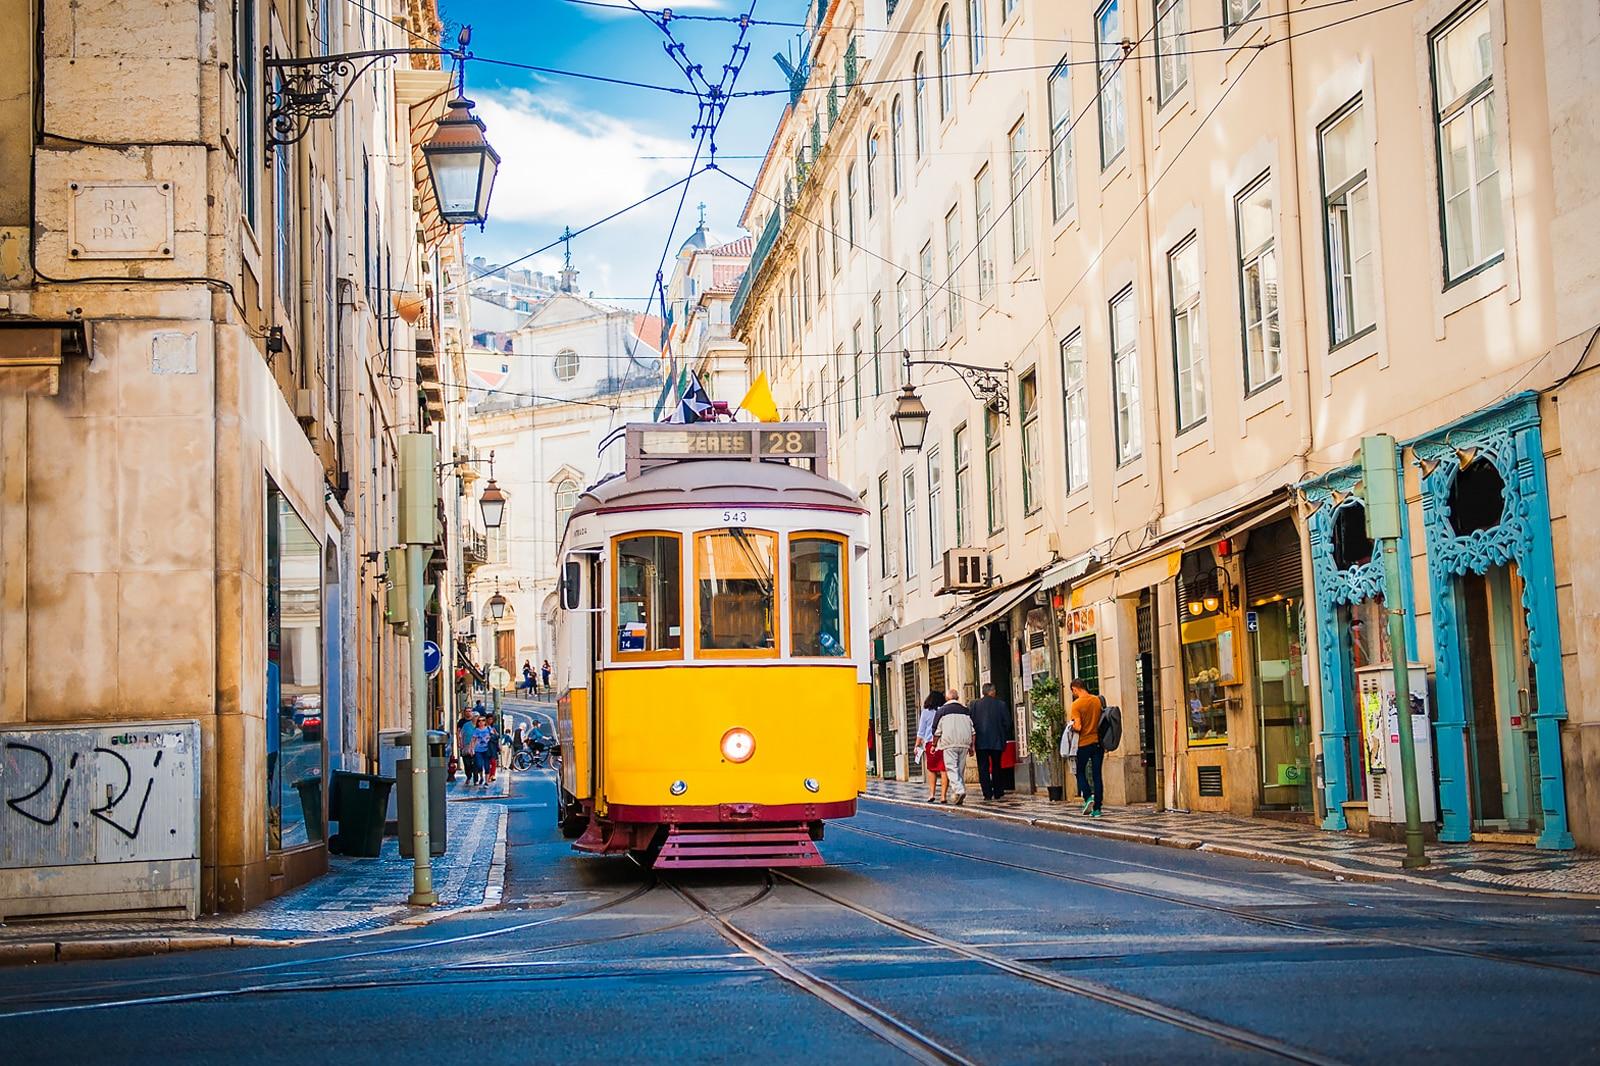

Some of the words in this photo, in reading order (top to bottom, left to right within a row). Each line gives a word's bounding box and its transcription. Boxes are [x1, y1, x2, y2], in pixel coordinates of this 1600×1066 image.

[110, 214, 132, 225] DA
[769, 432, 803, 454] 28
[722, 511, 748, 523] 543
